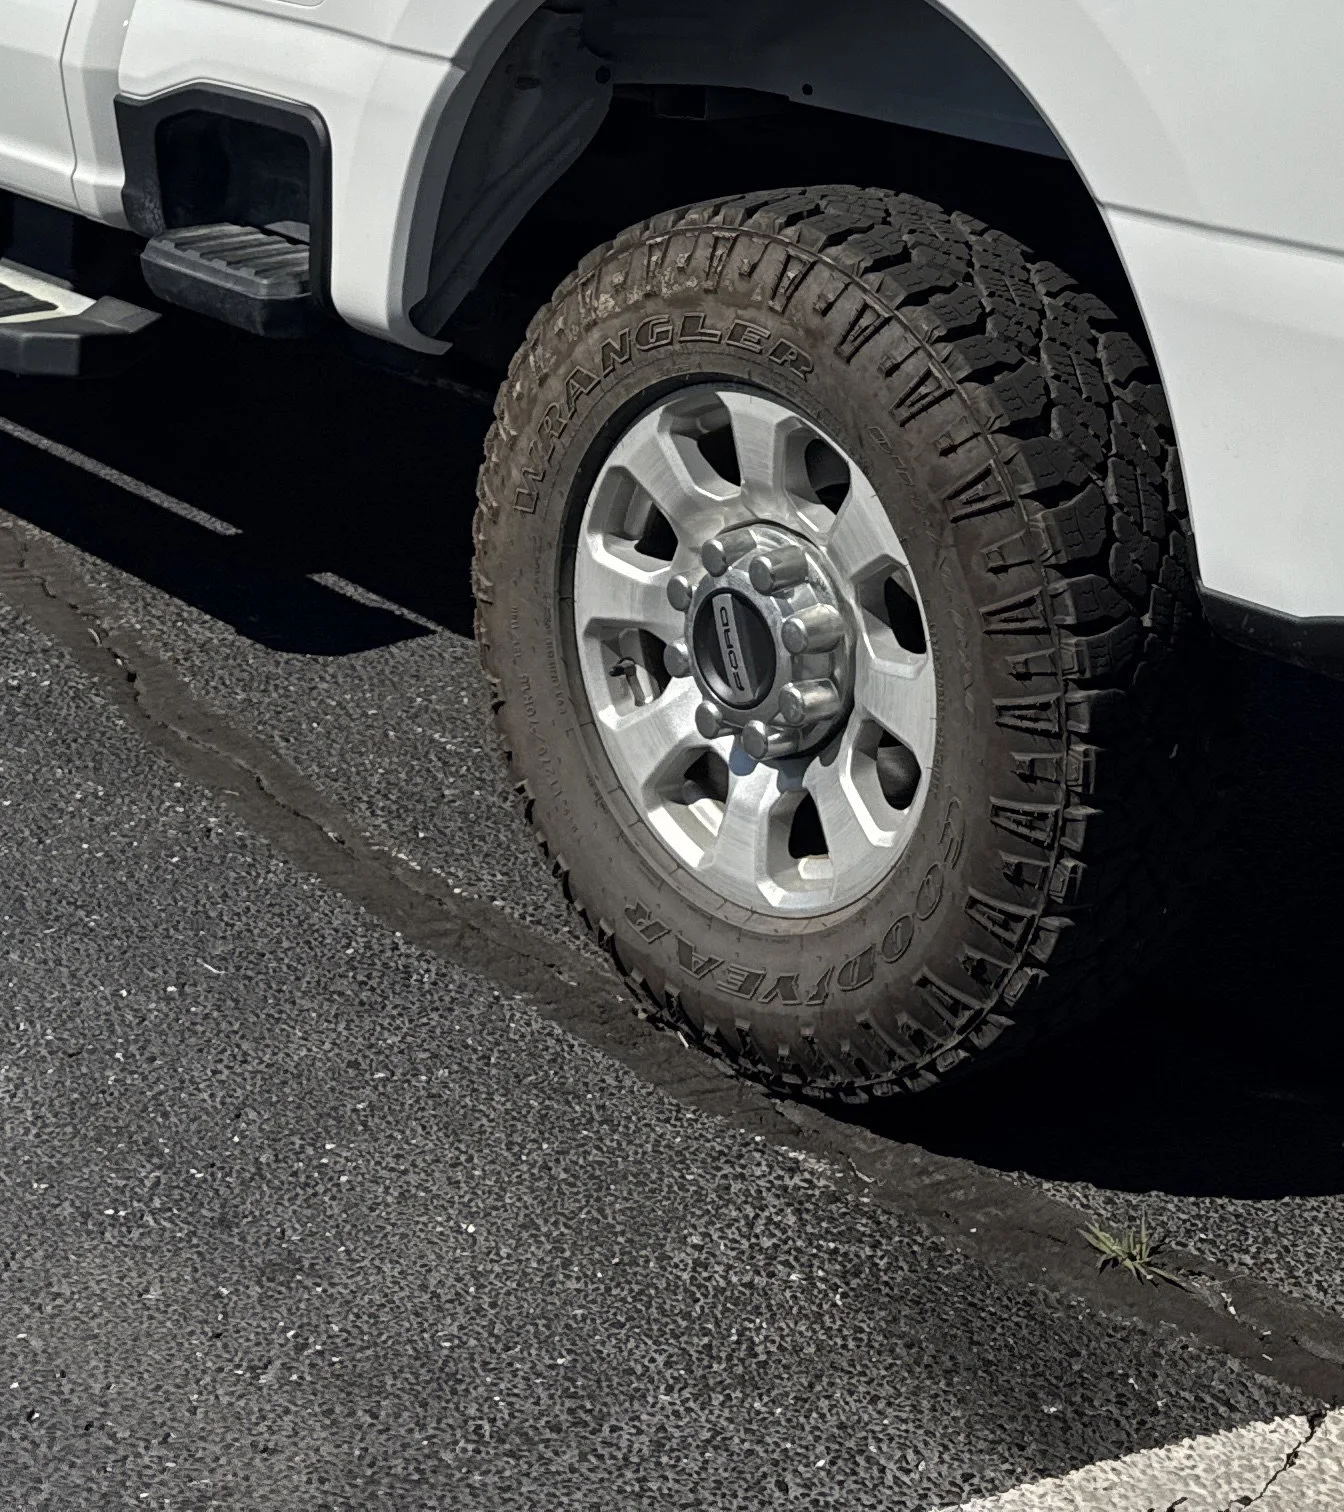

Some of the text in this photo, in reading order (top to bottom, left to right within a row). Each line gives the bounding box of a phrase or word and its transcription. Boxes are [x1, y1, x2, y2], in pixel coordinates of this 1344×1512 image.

[512, 311, 816, 516] WRANGLER
[719, 606, 745, 691] FORD
[624, 796, 967, 1006] GOODYEAR
